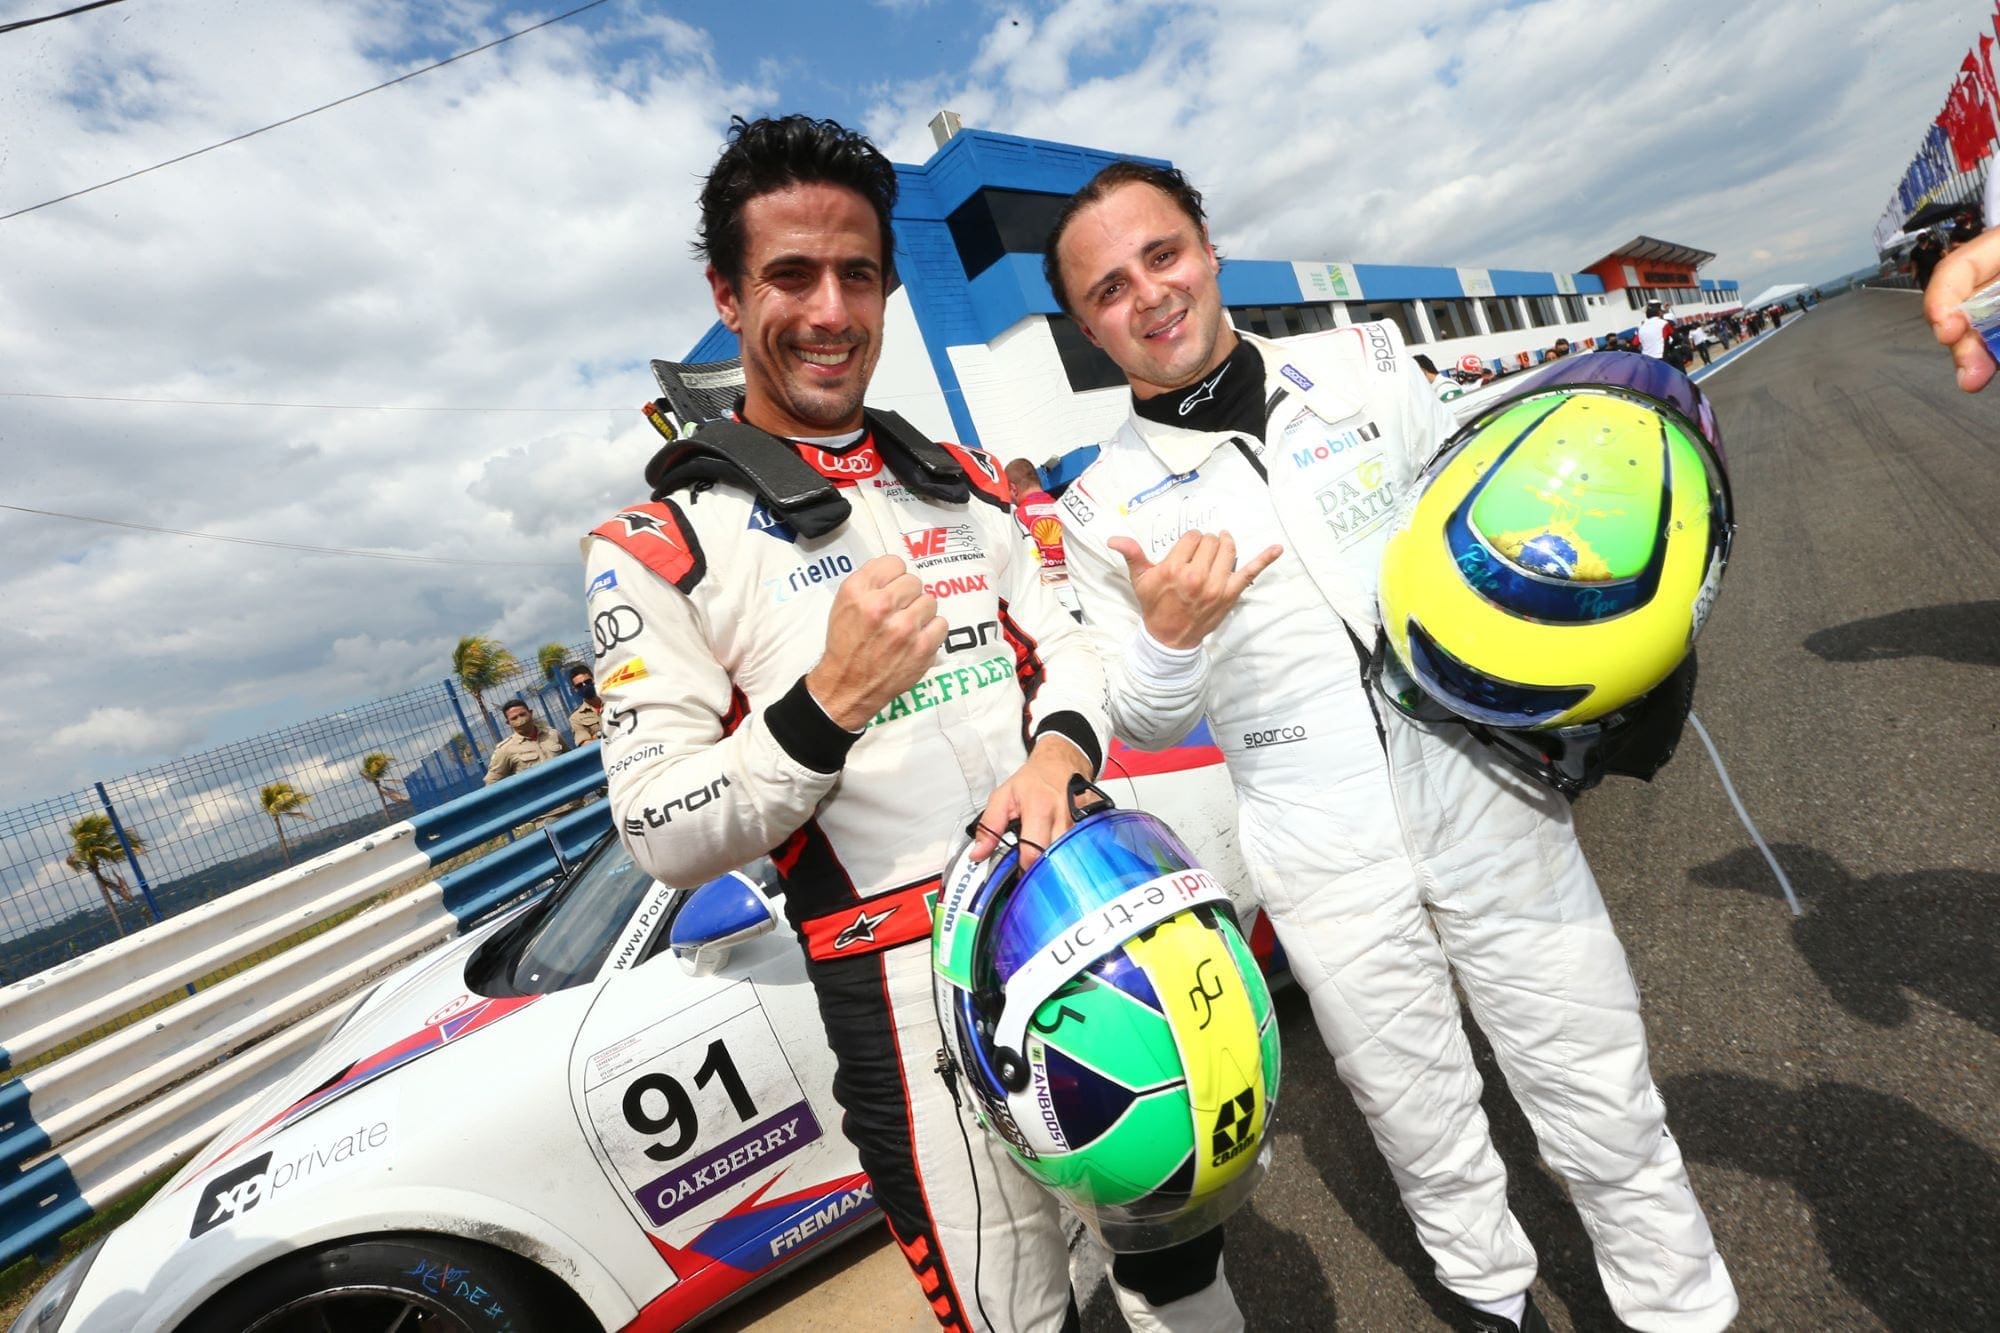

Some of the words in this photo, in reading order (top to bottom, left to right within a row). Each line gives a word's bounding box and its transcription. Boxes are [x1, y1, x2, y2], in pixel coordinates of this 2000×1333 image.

[1363, 323, 1396, 372] sparc
[1292, 430, 1359, 470] Mobil
[1315, 480, 1361, 516] DA
[1326, 482, 1397, 540] NATU
[902, 527, 947, 559] WE
[944, 552, 986, 564] ELEKTRONIK
[788, 555, 853, 592] riello
[923, 574, 989, 599] SONAX
[1243, 724, 1307, 749] sparco
[607, 743, 665, 780] cepoint
[622, 1038, 759, 1162] 91
[270, 1122, 388, 1200] private
[657, 1118, 800, 1210] OAKBERRY
[770, 1183, 873, 1257] FREMAX
